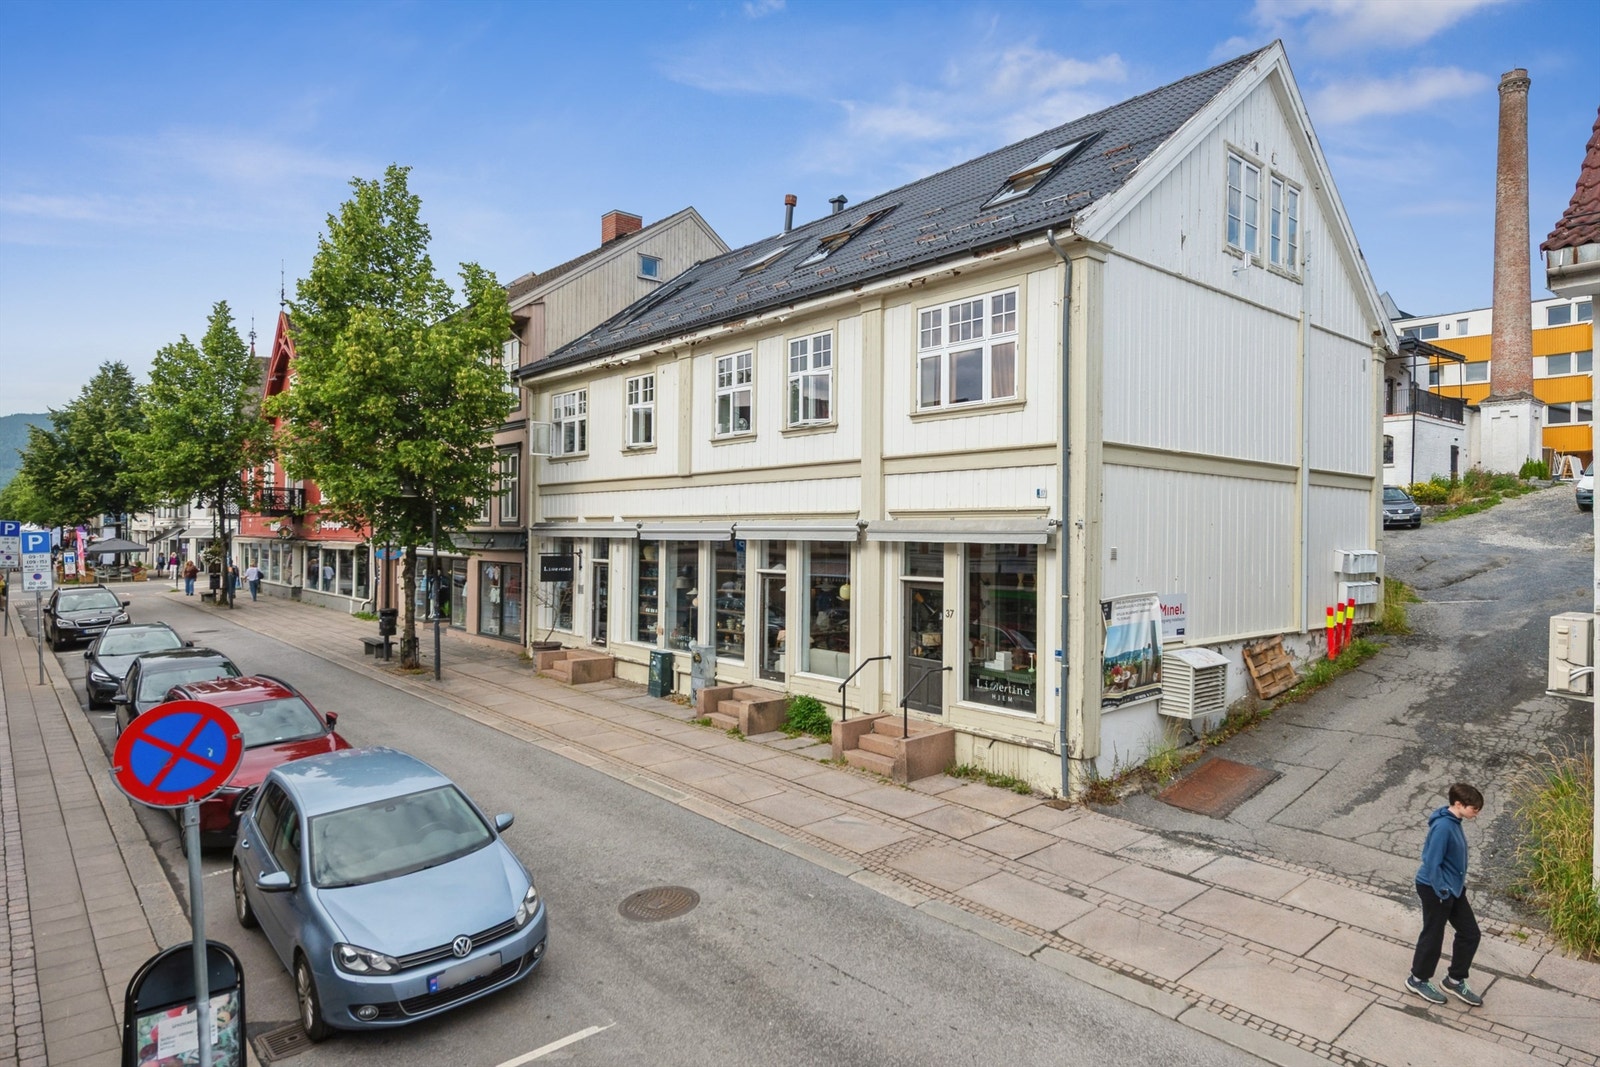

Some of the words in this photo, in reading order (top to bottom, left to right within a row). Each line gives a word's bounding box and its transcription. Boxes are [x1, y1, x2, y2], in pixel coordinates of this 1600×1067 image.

[5, 523, 15, 535] P
[28, 535, 43, 551] P
[945, 609, 954, 618] 37
[1160, 603, 1184, 616] Minel.
[976, 679, 1030, 697] Libertine
[991, 693, 1013, 703] HJEM
